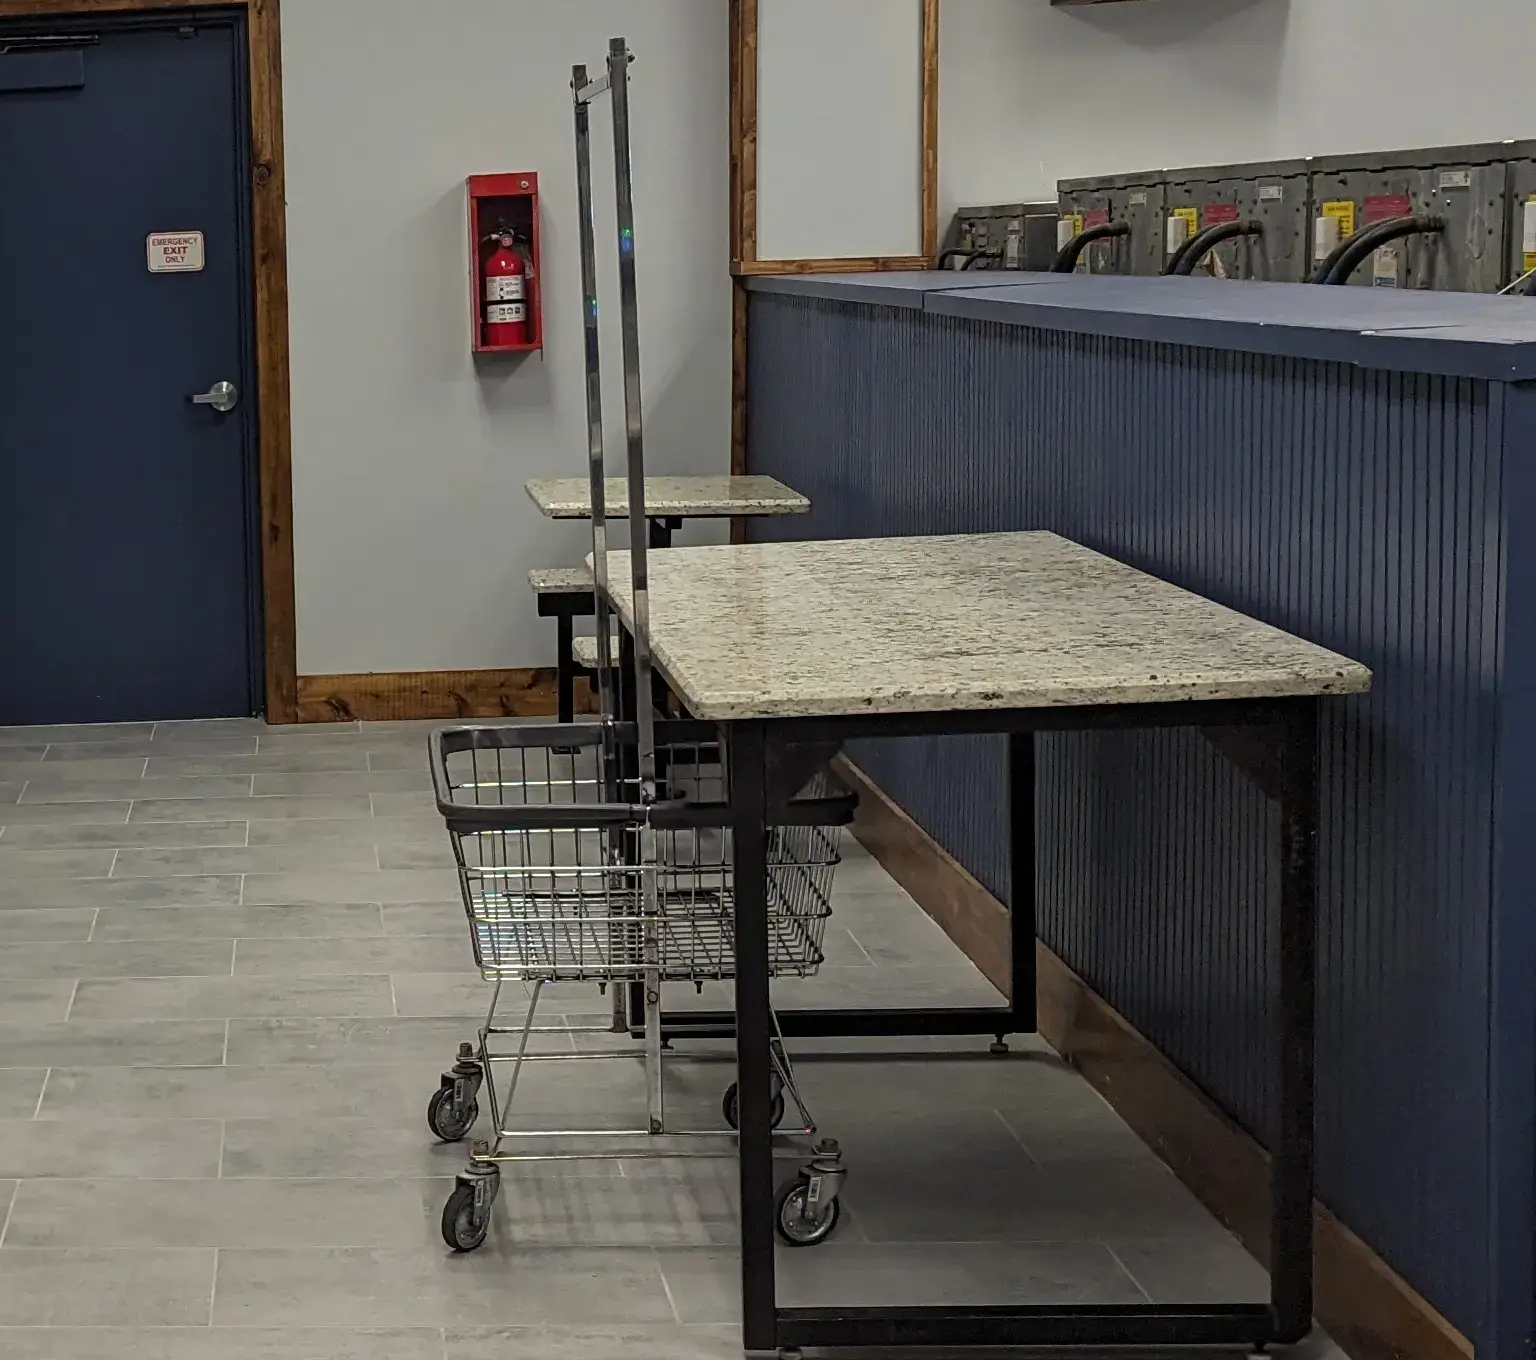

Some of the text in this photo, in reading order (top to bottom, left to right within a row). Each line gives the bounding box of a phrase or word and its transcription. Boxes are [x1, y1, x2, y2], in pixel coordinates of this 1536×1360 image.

[151, 236, 198, 246] EMERGENCY
[163, 246, 188, 255] EXIT
[165, 255, 185, 263] ONLY
